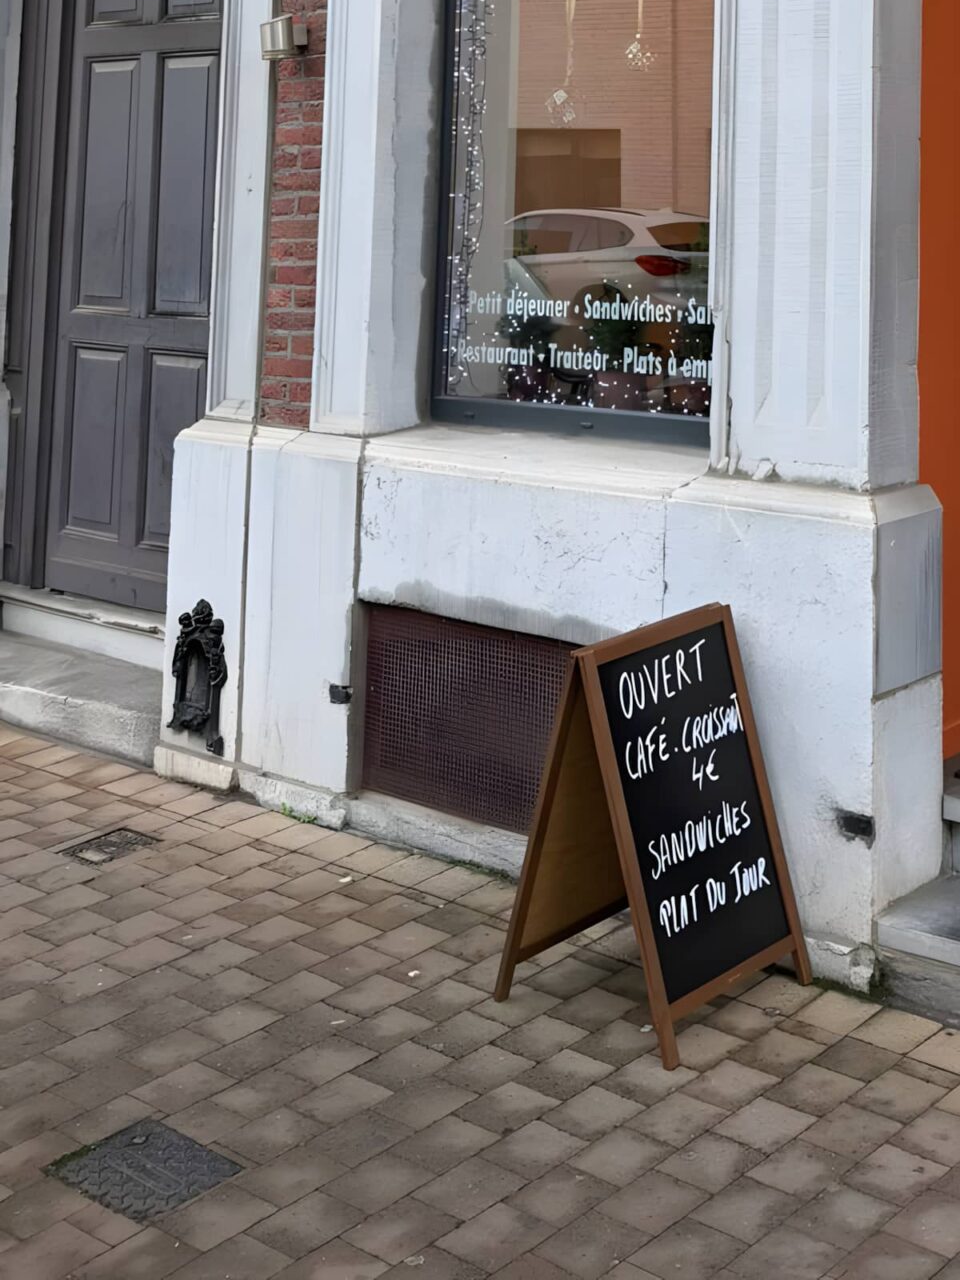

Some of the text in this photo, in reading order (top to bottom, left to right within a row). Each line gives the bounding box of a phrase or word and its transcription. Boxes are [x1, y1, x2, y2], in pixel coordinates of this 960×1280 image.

[469, 290, 502, 314] Petit
[507, 291, 570, 322] déjeuner
[584, 294, 672, 322] Sandwiches
[457, 338, 535, 366] Restaurant
[548, 343, 610, 371] Traiteur
[623, 346, 662, 376] Plats
[668, 349, 677, 376] à
[619, 639, 706, 719] OUVERT
[625, 717, 669, 780] CAFÉ
[692, 749, 720, 791] 4€
[659, 857, 771, 937] PLAT DU JOUR
